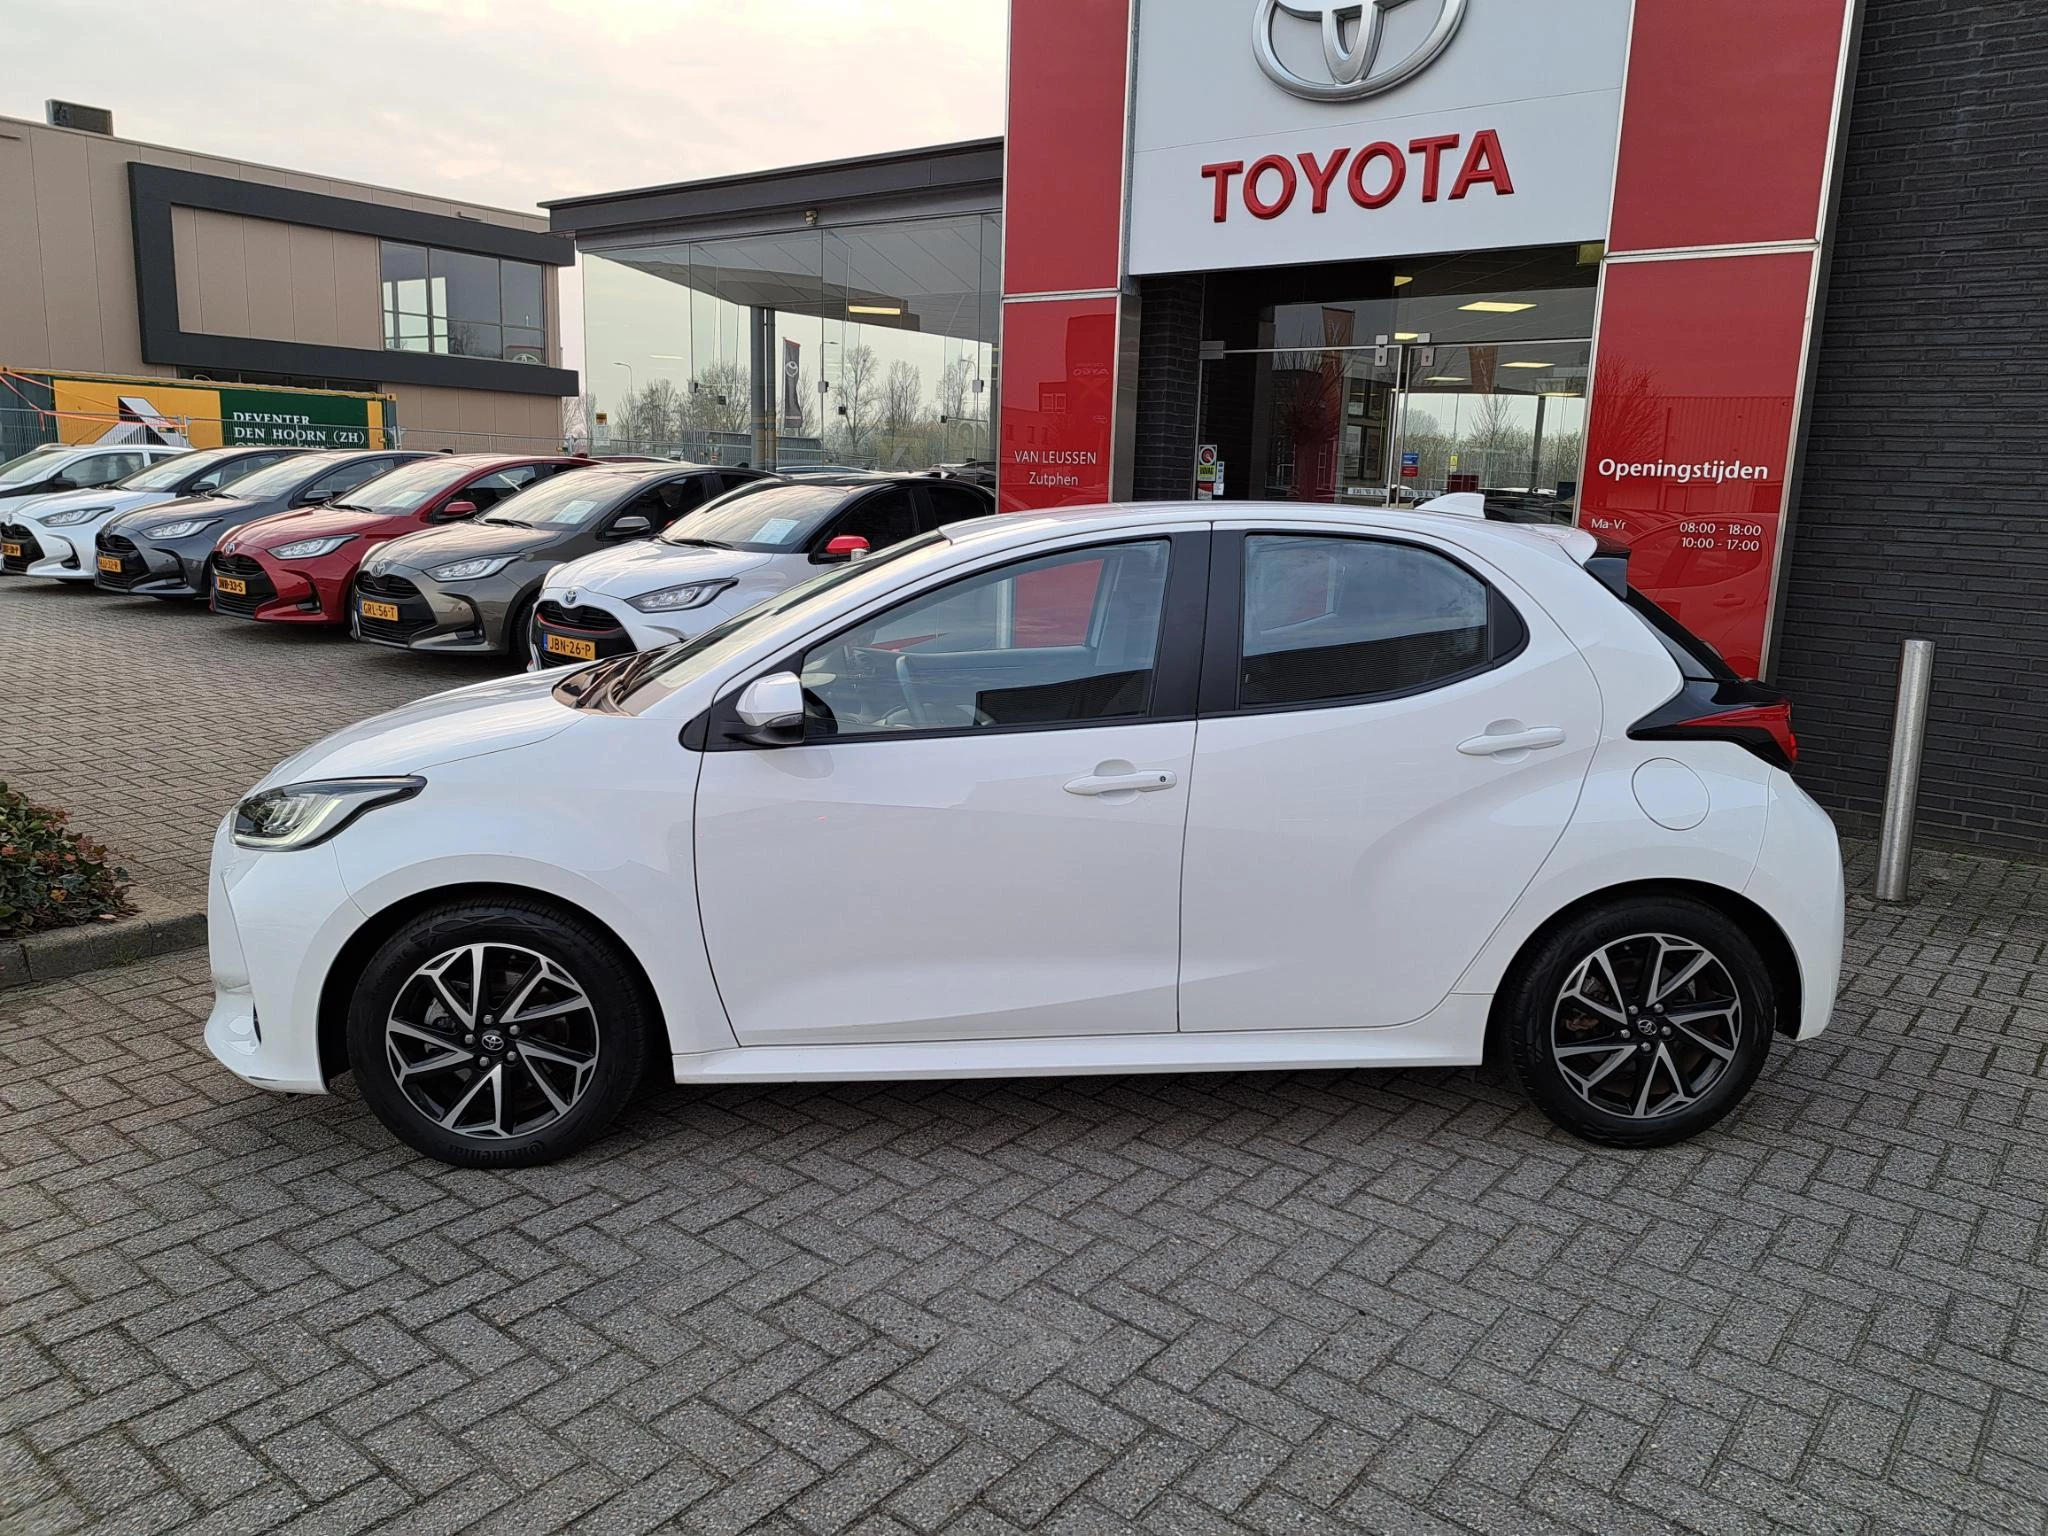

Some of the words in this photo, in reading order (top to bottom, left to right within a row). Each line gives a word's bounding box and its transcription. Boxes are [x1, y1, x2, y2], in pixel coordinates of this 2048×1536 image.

[1201, 129, 1514, 223] TOYOTA
[233, 412, 310, 425] DEVENTER
[234, 427, 265, 439] DEN
[273, 428, 326, 441] HOORN
[333, 431, 365, 445] (ZH)
[1014, 450, 1039, 463] VAN
[1042, 451, 1097, 465] LEUSSEN
[1029, 471, 1079, 488] Zutphen
[1598, 458, 1769, 484] Openingstijden
[1591, 518, 1626, 530] Ma-Vr
[1679, 522, 1716, 534] 08:00
[1728, 524, 1762, 536] 18:00
[1681, 537, 1714, 549] 10:00
[1727, 539, 1760, 551] 17:00
[363, 602, 395, 618] GRL-56-T
[550, 637, 592, 656] JBN-26-P
